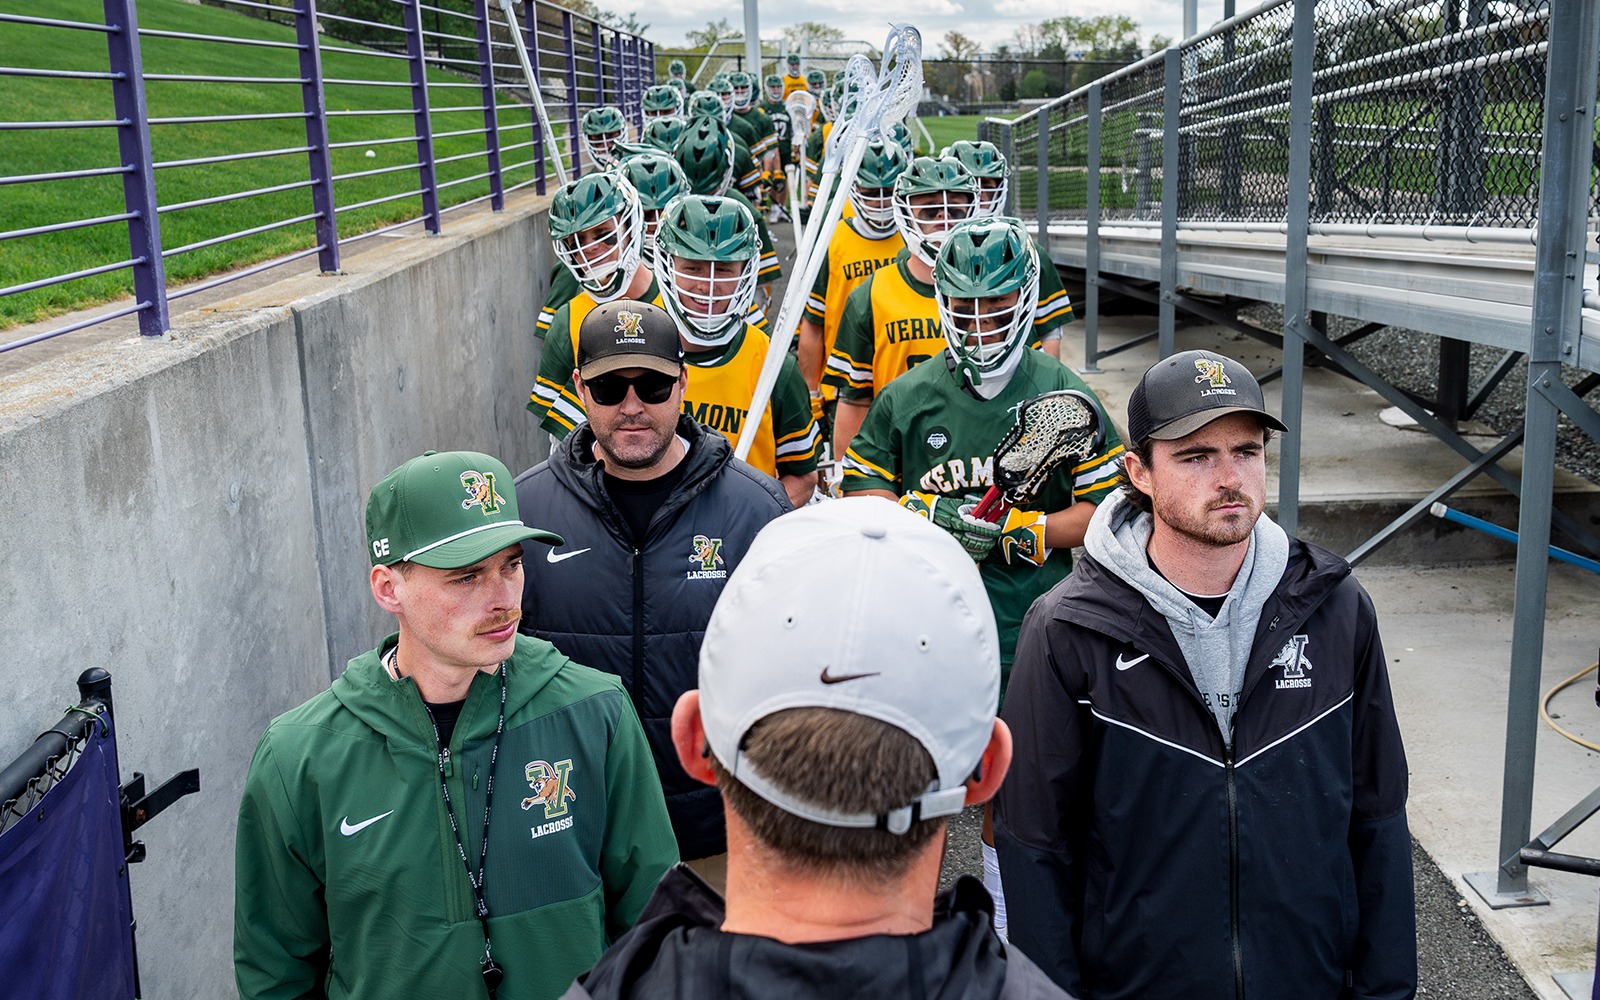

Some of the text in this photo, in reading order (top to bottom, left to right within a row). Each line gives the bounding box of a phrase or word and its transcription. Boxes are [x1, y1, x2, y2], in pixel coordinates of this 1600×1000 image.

[1200, 388, 1237, 397] LACROSSE
[682, 400, 749, 434] MON
[372, 537, 390, 558] CE
[686, 570, 727, 580] LACROSSE
[1275, 678, 1312, 690] LACROSSE
